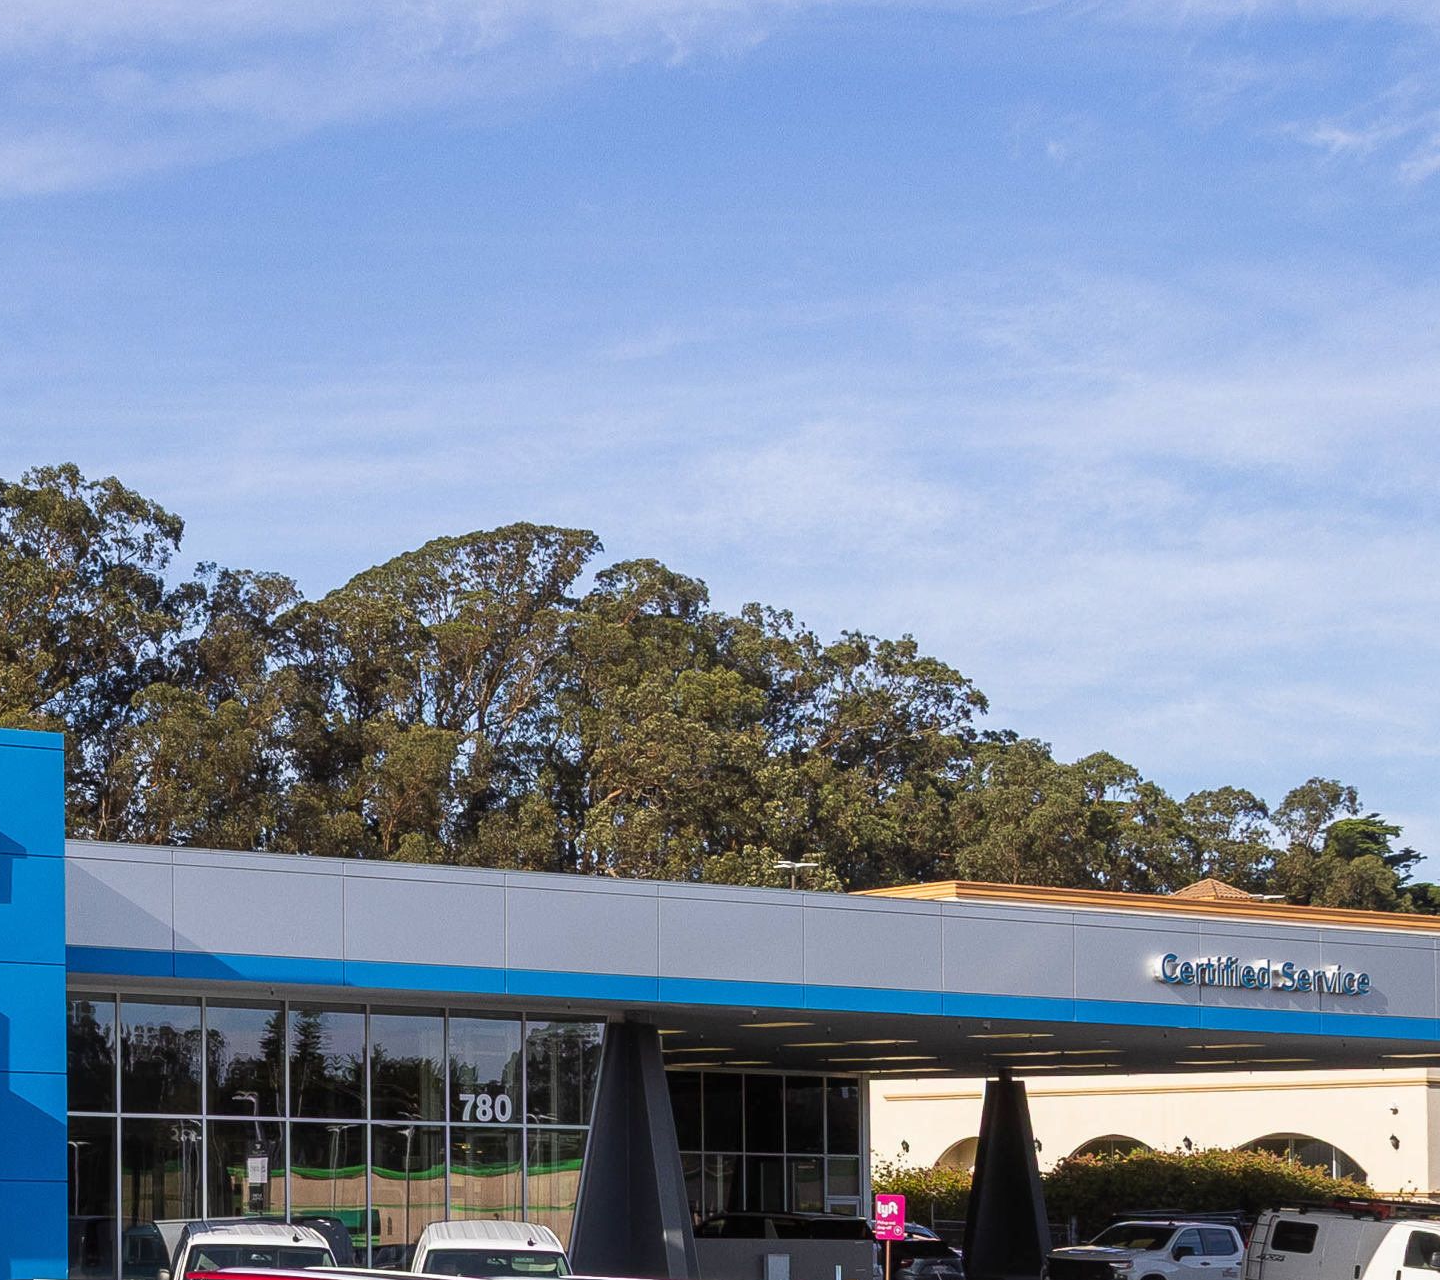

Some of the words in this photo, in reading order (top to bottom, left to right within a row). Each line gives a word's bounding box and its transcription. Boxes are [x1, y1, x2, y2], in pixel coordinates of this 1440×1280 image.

[1159, 952, 1272, 990] Certified
[1280, 961, 1371, 996] Service
[459, 1093, 512, 1122] 780
[877, 1201, 898, 1218] lyft
